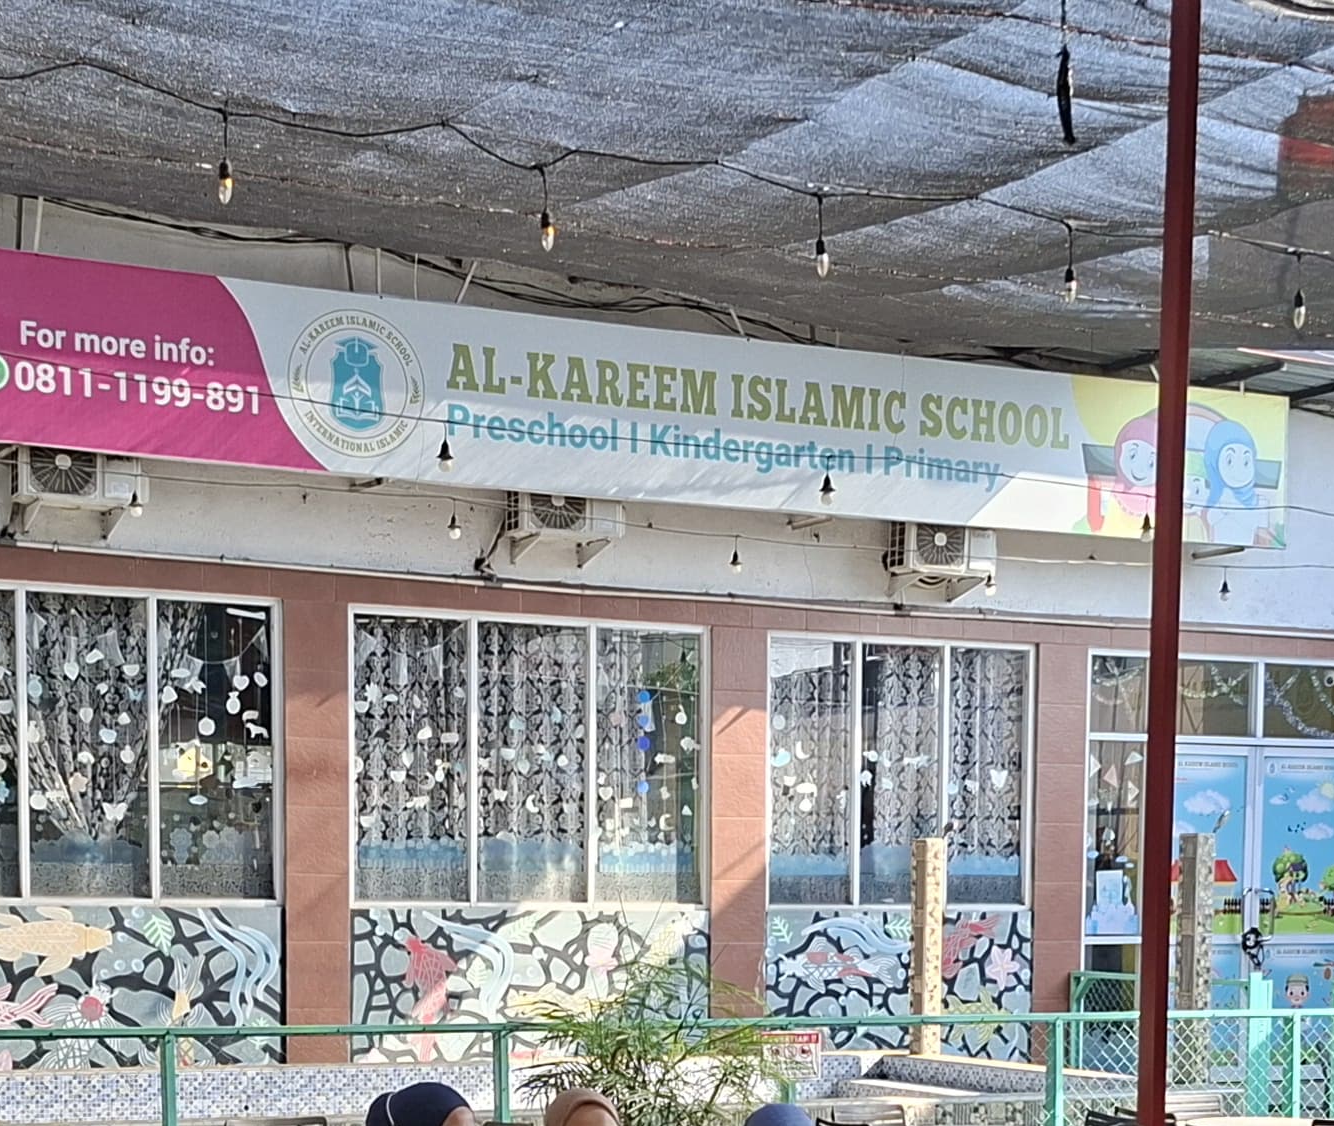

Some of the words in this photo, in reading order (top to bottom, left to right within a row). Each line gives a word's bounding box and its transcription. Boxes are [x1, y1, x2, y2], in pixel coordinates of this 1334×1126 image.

[19, 320, 66, 350] For
[74, 330, 145, 358] more
[154, 335, 215, 366] info:
[346, 316, 386, 335] ISLAMIC
[385, 331, 413, 367] SCHOOL
[14, 361, 259, 415] 0811-1199-891
[446, 343, 717, 417] AL-KAREEM
[731, 373, 906, 434] ISLAMIC
[920, 393, 1070, 449] SCHOOL
[304, 410, 375, 453] INTERNATIONAL
[376, 420, 409, 451] ISLAMIC
[447, 403, 617, 452] Preschool
[650, 422, 855, 473] Kindergarten
[884, 446, 1001, 492] Primary
